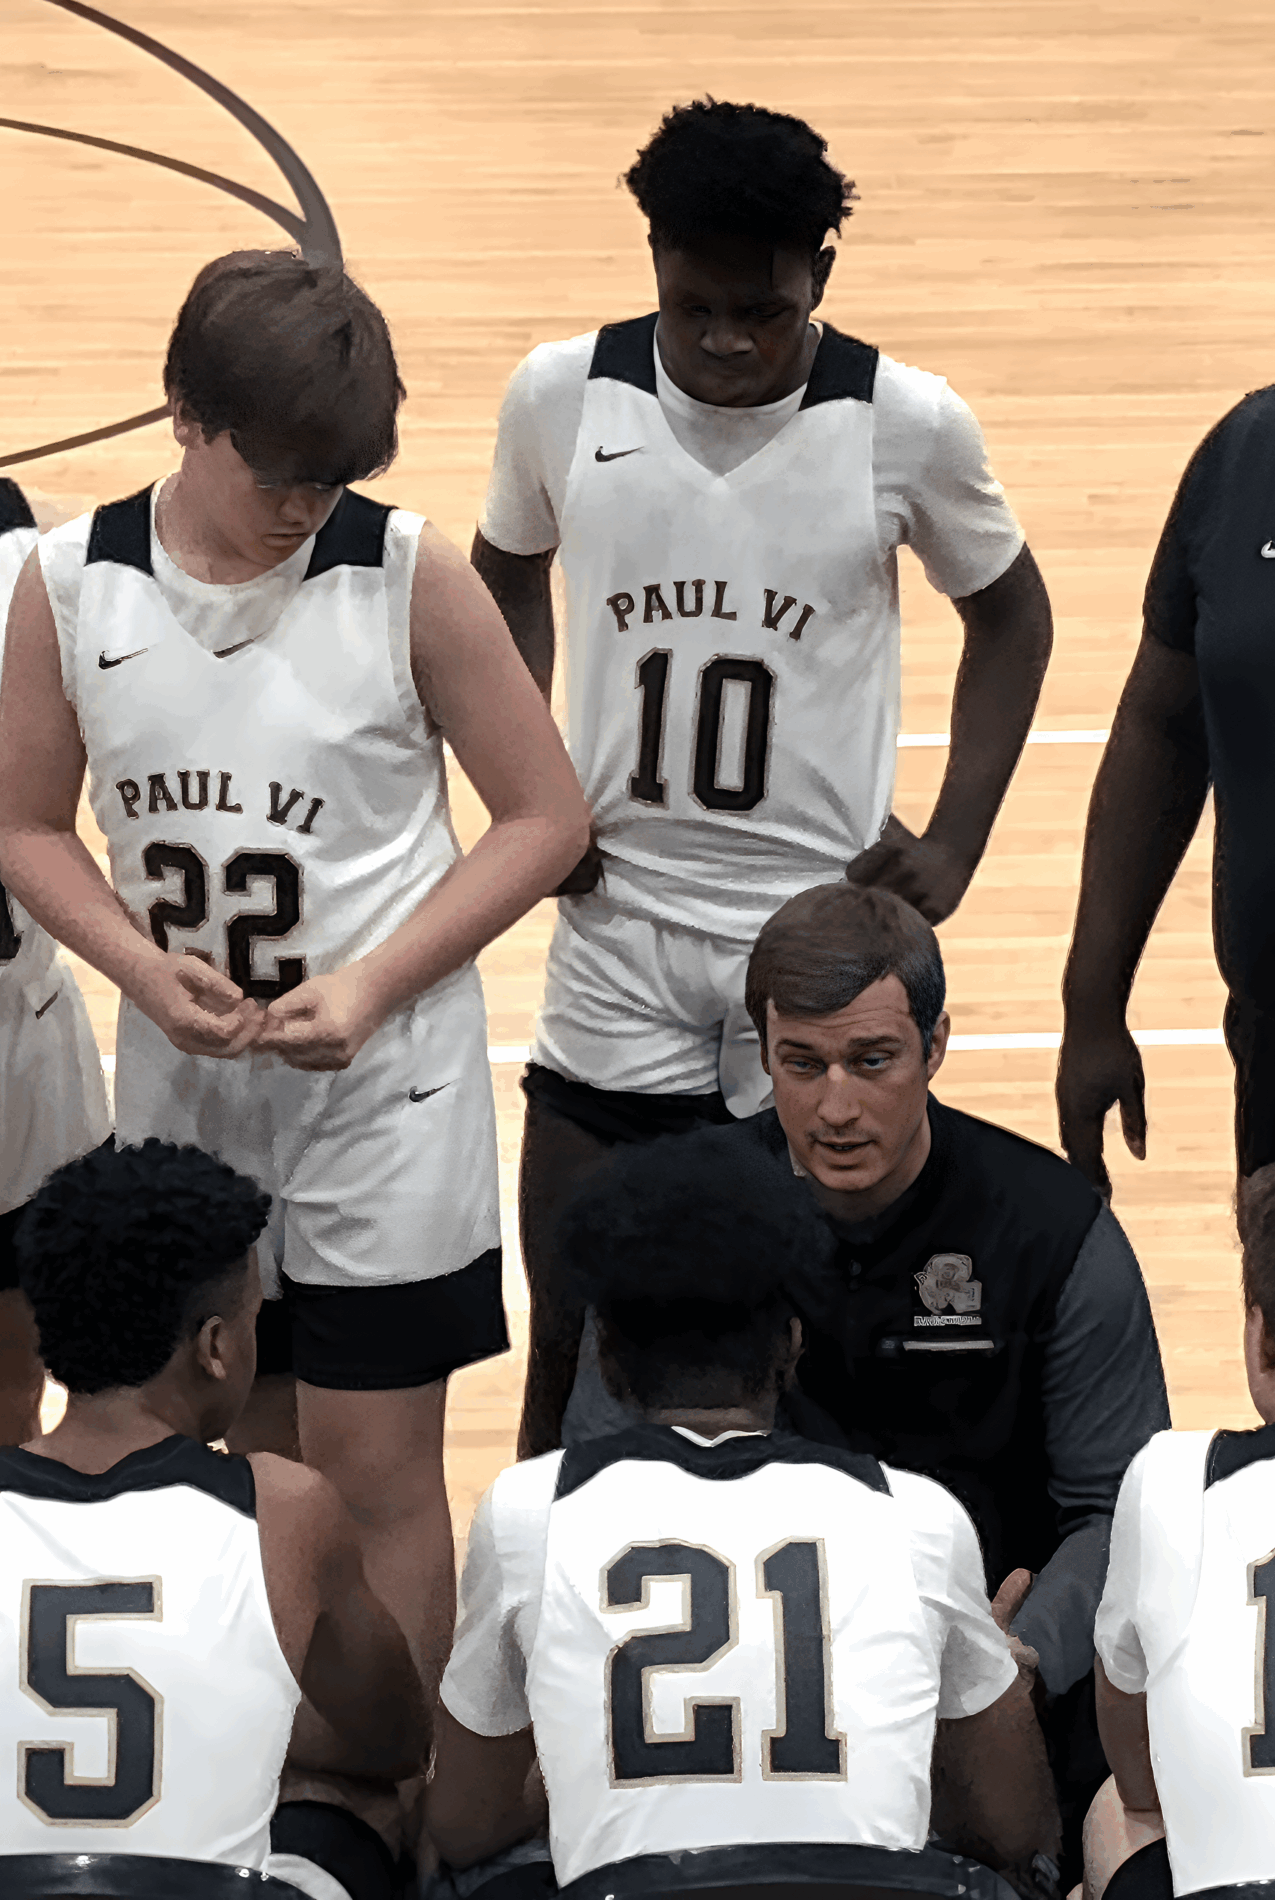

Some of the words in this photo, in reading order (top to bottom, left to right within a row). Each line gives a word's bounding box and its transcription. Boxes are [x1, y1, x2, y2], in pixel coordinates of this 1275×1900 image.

[606, 578, 738, 633] PAUL
[761, 588, 816, 642] VI
[115, 768, 244, 820] PAUL
[266, 780, 326, 834] VI
[628, 646, 778, 817] 10
[141, 840, 307, 999] 22
[16, 1574, 164, 1829] 5
[600, 1537, 848, 1789] 21
